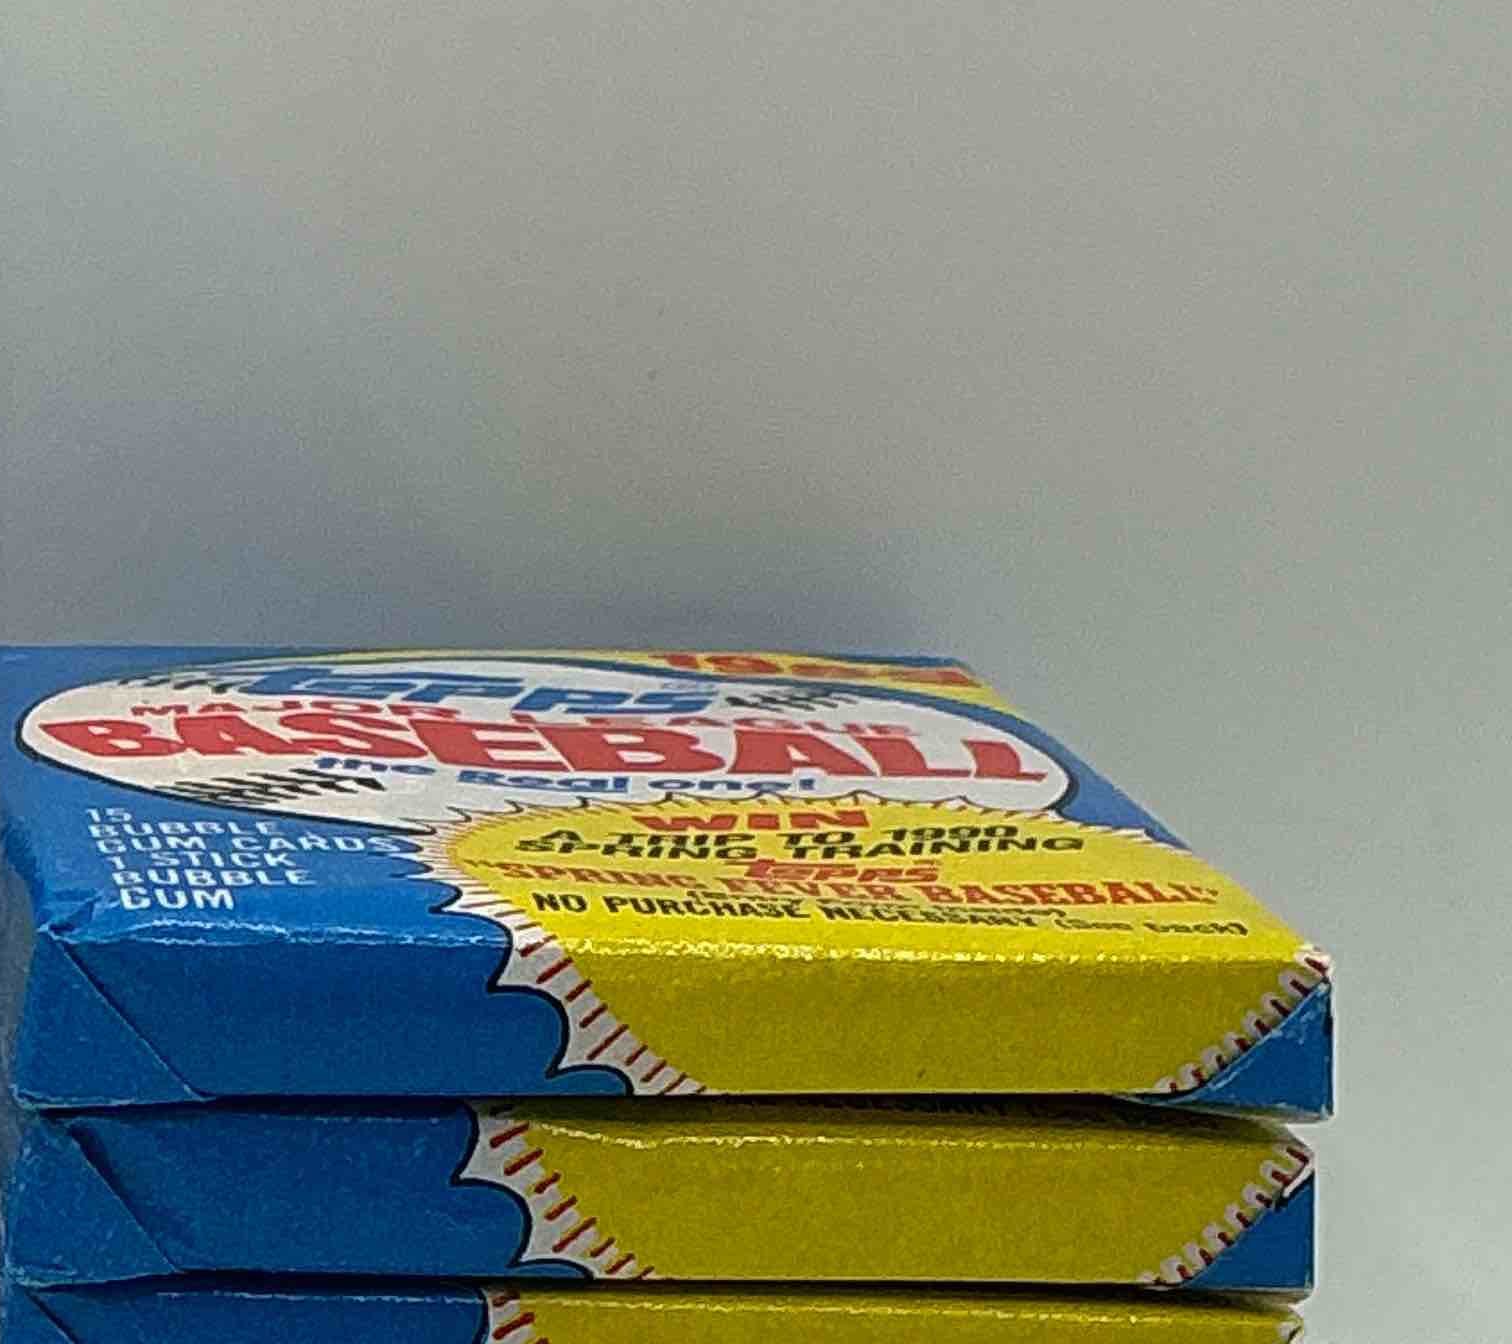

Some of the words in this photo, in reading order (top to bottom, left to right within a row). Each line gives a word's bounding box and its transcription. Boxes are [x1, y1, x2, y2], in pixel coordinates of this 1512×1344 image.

[38, 711, 1048, 783] BASEBALL
[86, 807, 132, 824] 15
[630, 809, 871, 832] WIN
[89, 821, 288, 838] BUBBLE
[97, 836, 207, 854] GUM
[231, 835, 402, 852] CARDS
[790, 836, 1086, 860] TRAINING
[150, 851, 298, 869] STICK
[111, 868, 318, 887] BUBBLE
[119, 887, 235, 911] GUM
[531, 892, 589, 912] NO
[602, 895, 811, 919] PURCHASE
